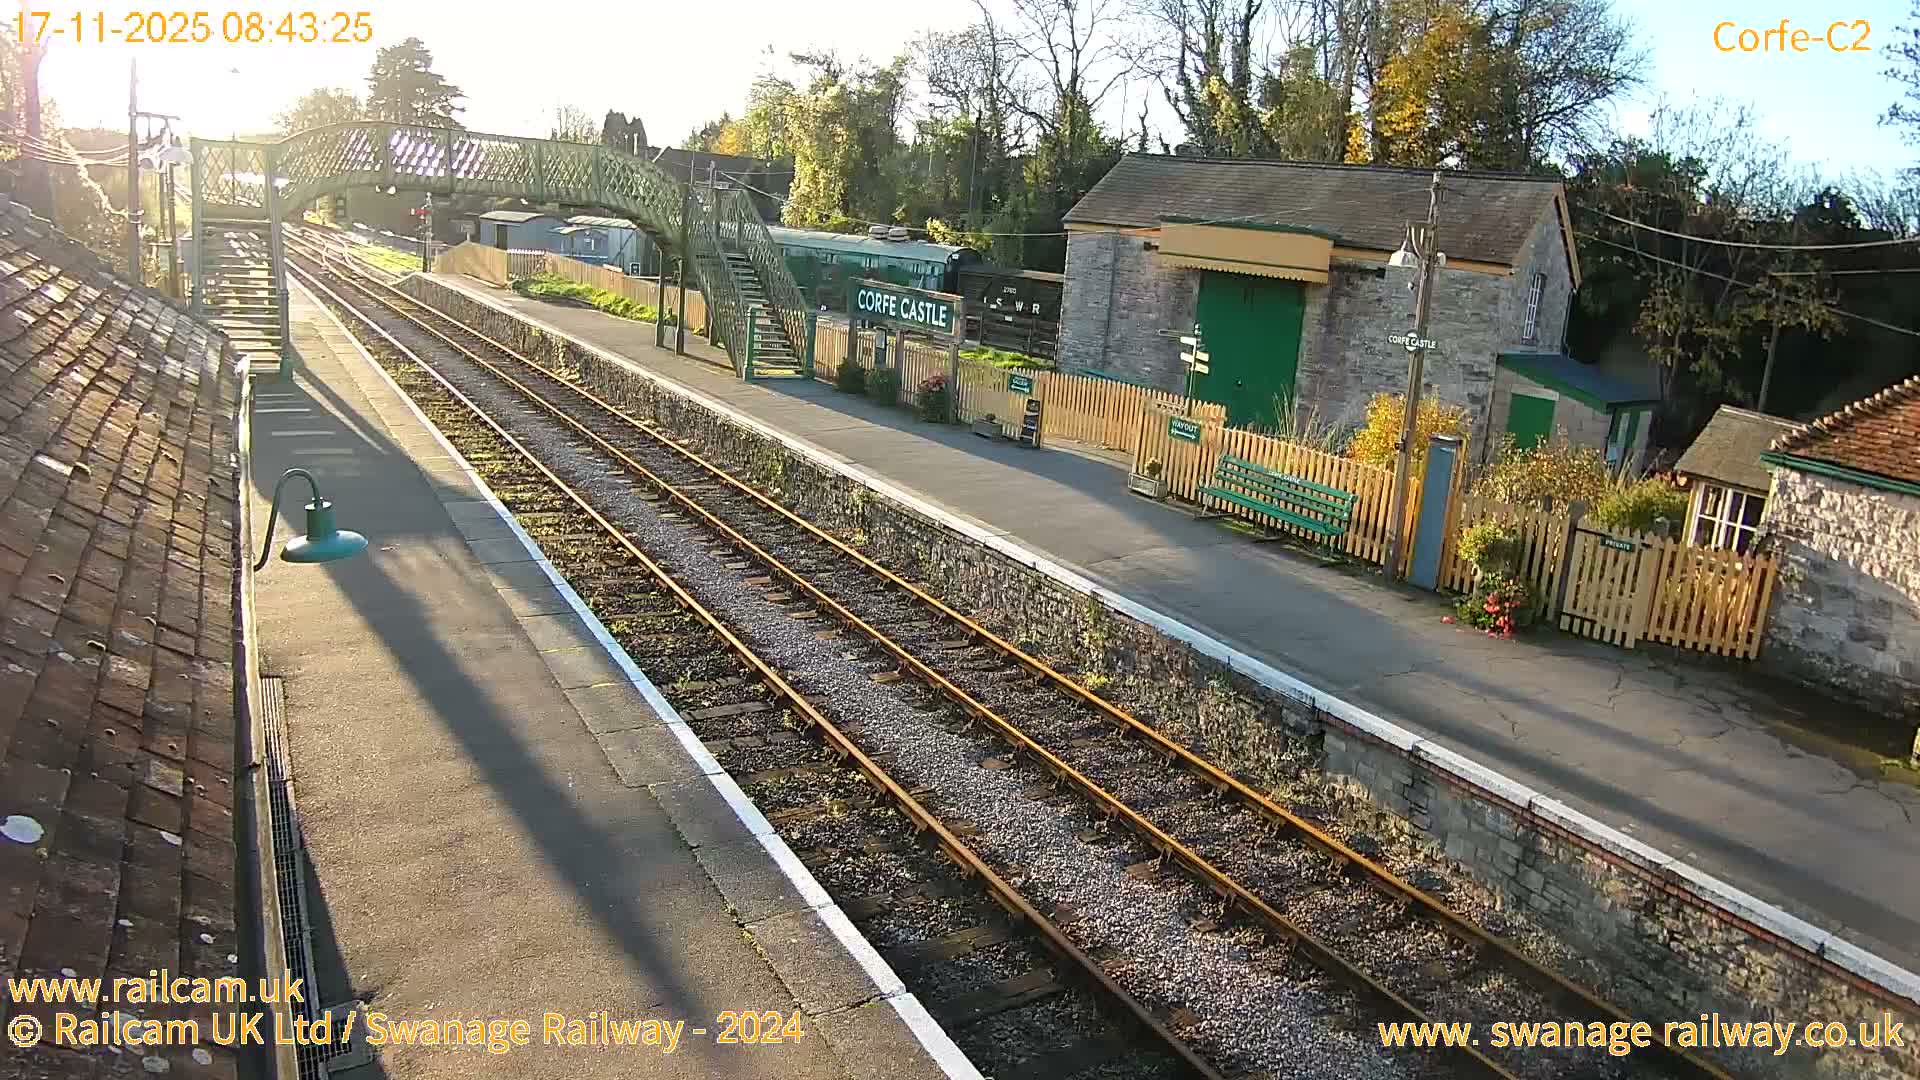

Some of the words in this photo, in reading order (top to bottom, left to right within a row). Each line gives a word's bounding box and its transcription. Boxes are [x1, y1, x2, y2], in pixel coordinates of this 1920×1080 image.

[857, 289, 897, 317] CORFE
[900, 298, 947, 328] CASTLE
[1388, 335, 1410, 346] CORFE
[1410, 338, 1436, 349] CASTLE
